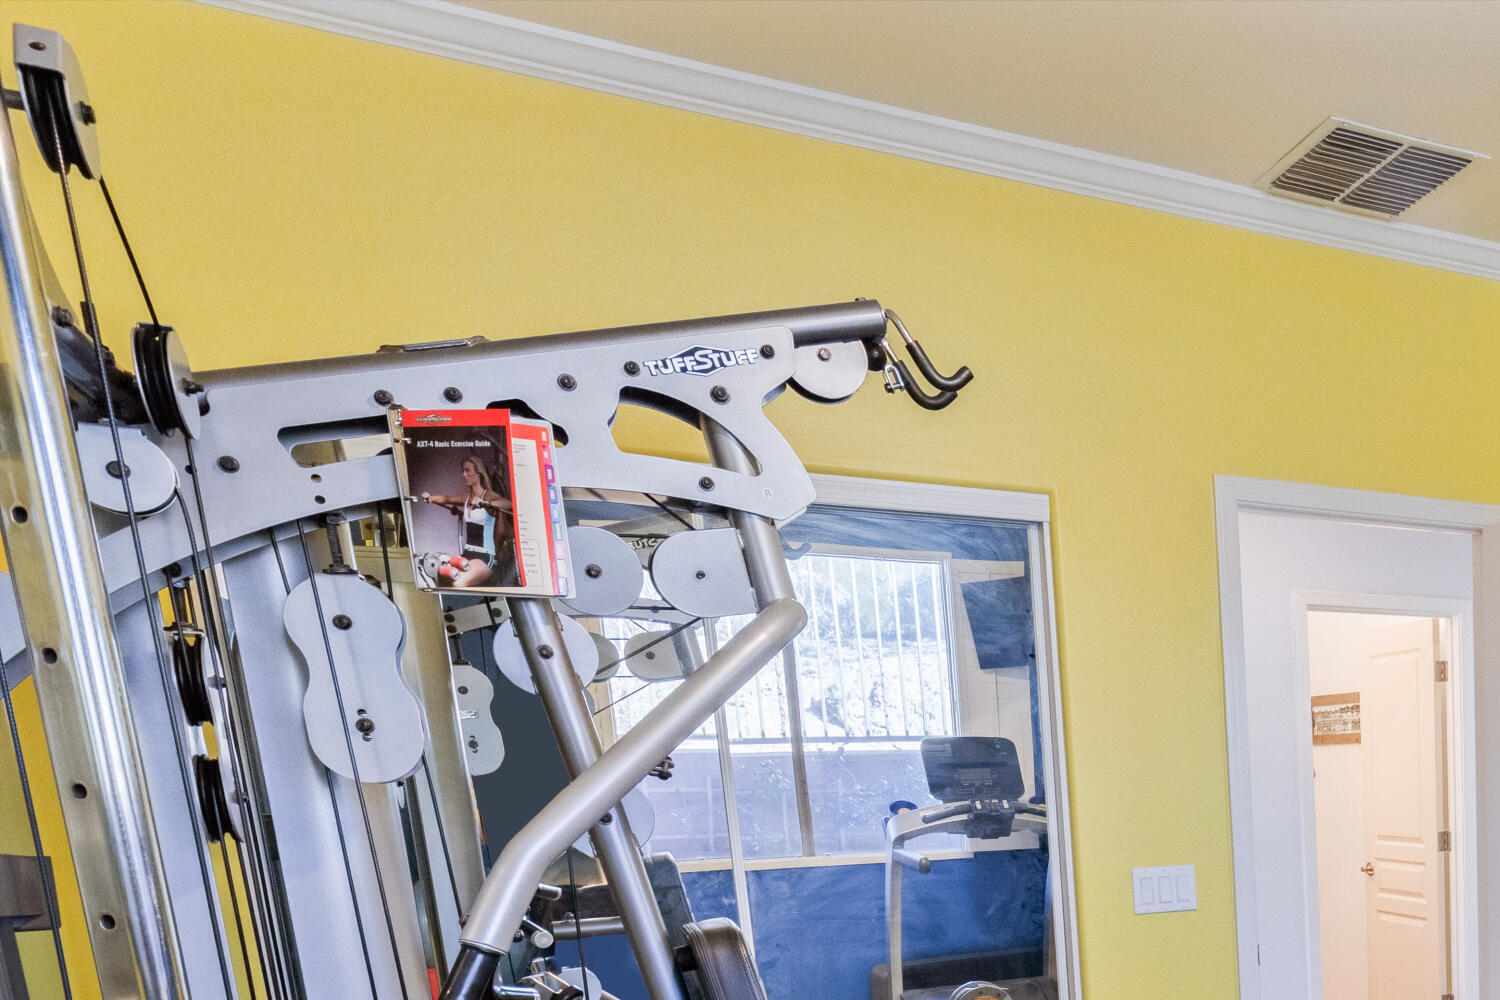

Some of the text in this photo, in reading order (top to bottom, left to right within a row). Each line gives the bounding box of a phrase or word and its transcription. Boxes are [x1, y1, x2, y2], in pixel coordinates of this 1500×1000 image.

[643, 348, 759, 376] TUFFSTUFF
[434, 440, 450, 448] Basic
[450, 440, 475, 448] Exercise
